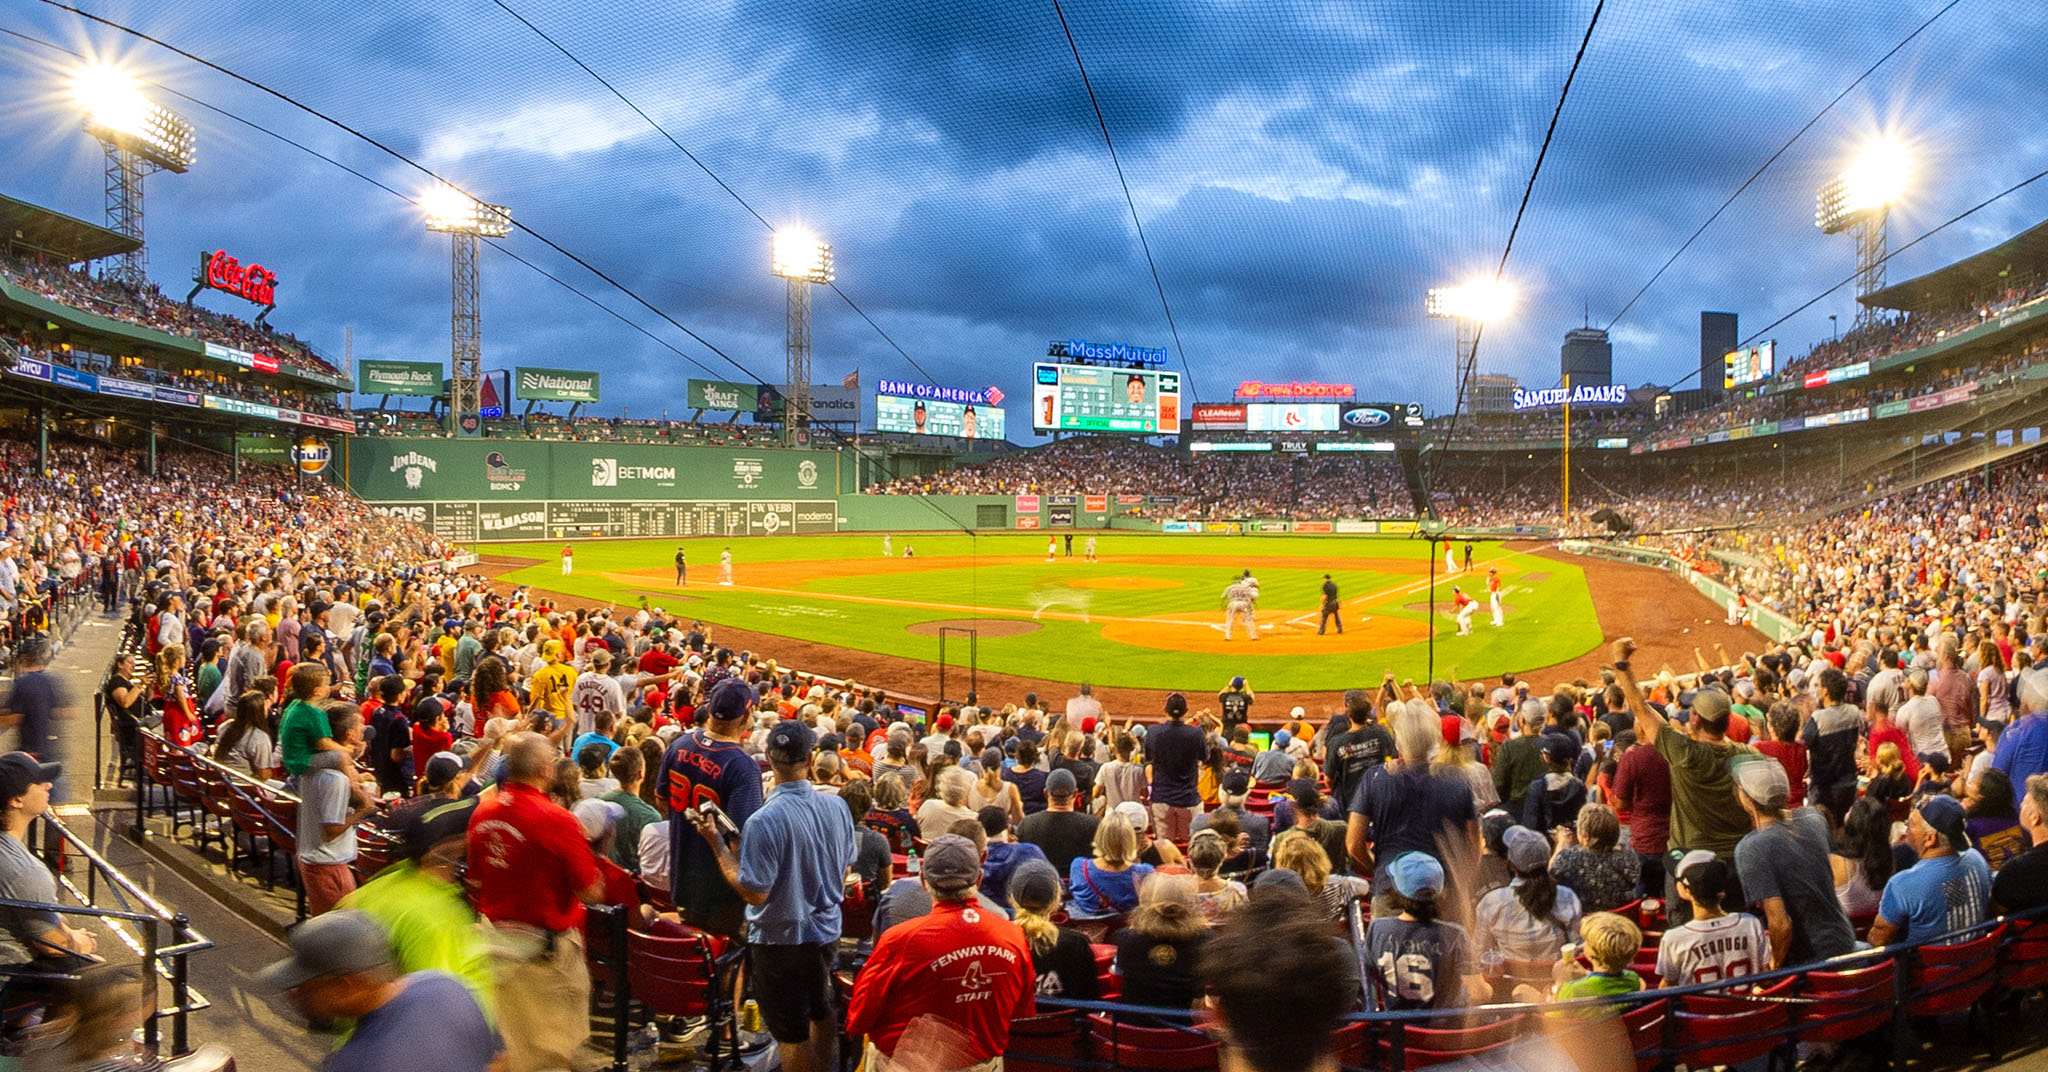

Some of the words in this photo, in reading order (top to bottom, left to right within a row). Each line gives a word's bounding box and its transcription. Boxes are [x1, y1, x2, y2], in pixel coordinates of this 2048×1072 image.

[208, 249, 277, 306] Coca-Cola
[1069, 339, 1167, 363] MassMutual
[369, 369, 410, 381] Plymouth
[411, 370, 433, 381] Rock
[539, 374, 592, 391] National
[704, 391, 739, 401] DRAFT
[879, 379, 915, 396] BANK
[916, 384, 934, 397] OF
[933, 386, 983, 403] AMERICA
[1263, 384, 1291, 397] new
[1292, 381, 1354, 397] balance
[709, 400, 739, 409] KINGS
[1513, 388, 1572, 410] SAMUEL
[1572, 385, 1626, 404] ADAMS
[1353, 411, 1381, 424] Ford
[1281, 441, 1307, 449] TRULY
[294, 447, 329, 461] Gulf
[389, 455, 409, 473] JIM
[408, 450, 437, 473] BEAM
[618, 466, 676, 480] BETMGM
[389, 506, 427, 522] CVS
[767, 503, 793, 513] WEBB
[797, 511, 833, 521] moderna
[549, 673, 569, 693] 14
[580, 693, 604, 714] 49
[677, 748, 722, 781] TUCKER
[1691, 935, 1749, 961] VERDUGO
[930, 945, 986, 972] FENWAY
[987, 945, 1017, 965] PARK
[1377, 951, 1435, 1003] 16
[955, 990, 993, 1004] STAFF
